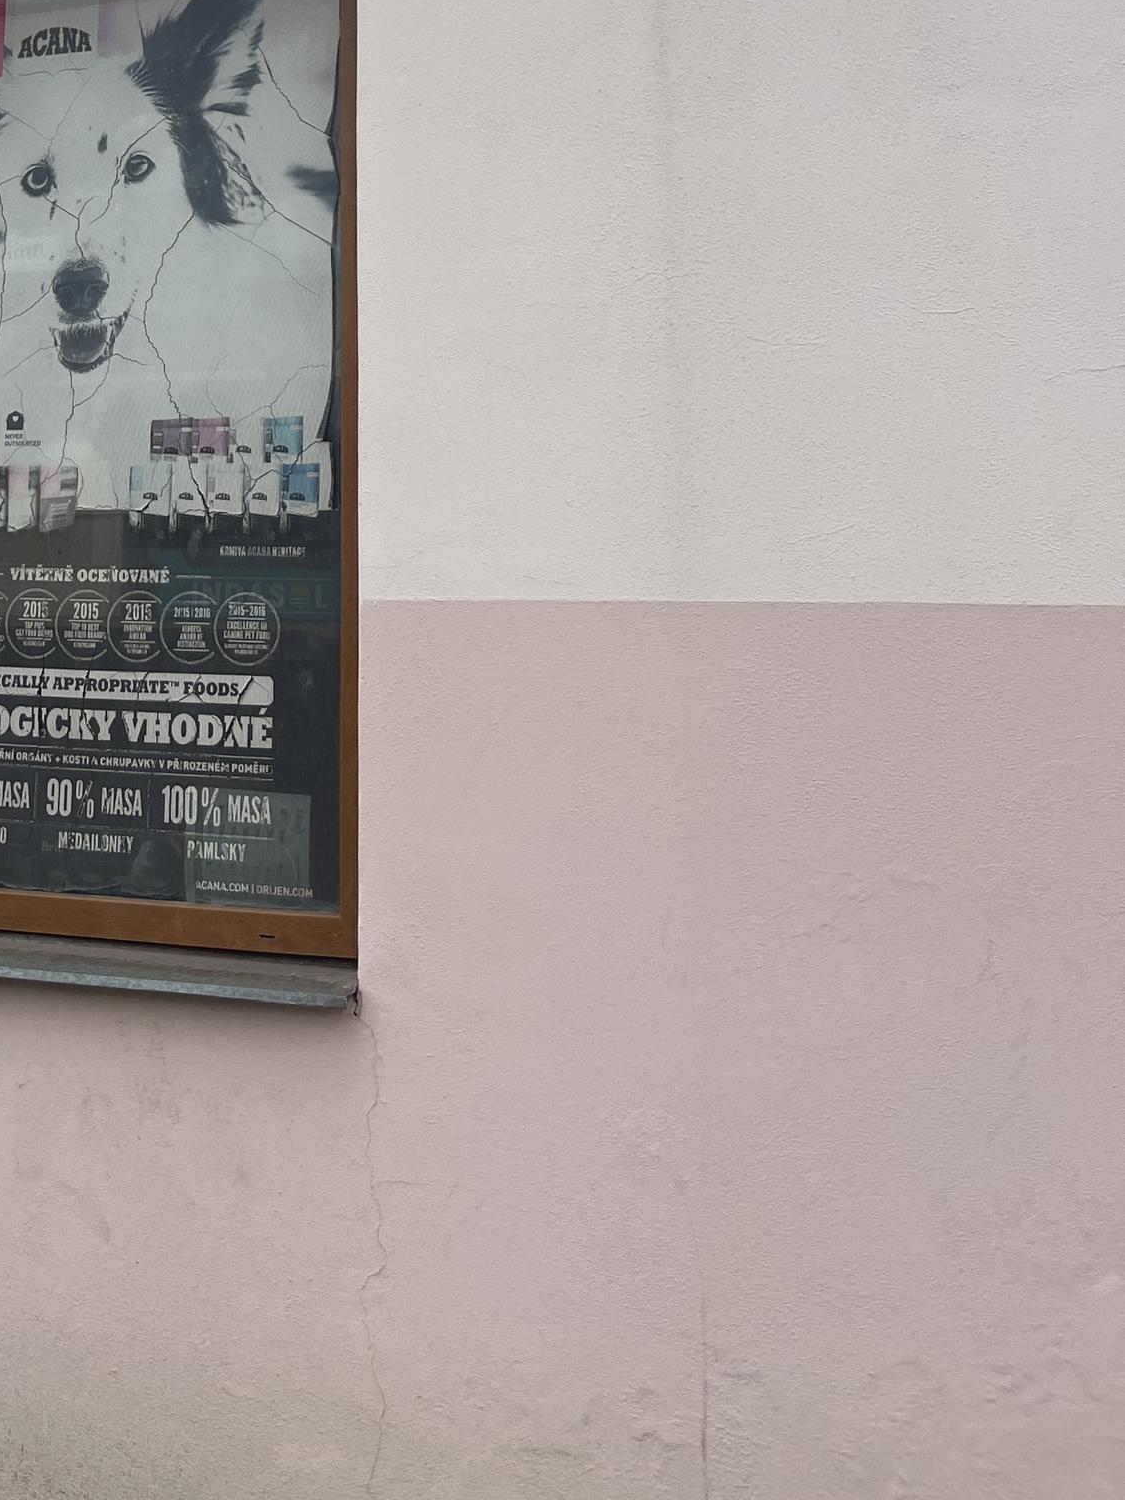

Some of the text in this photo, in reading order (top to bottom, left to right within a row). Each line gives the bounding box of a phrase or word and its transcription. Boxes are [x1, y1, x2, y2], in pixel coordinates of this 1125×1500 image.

[18, 26, 92, 59] ACANA
[219, 545, 246, 557] KRMIVA
[10, 564, 170, 583] VÍTĚZNĚ OCEŇOVANÉ
[22, 601, 49, 618] 2015
[73, 602, 99, 619] 2015
[125, 603, 152, 621] 2015
[227, 621, 260, 630] EXCELLENCE
[223, 631, 244, 639] CANINE
[244, 631, 255, 640] PET
[183, 681, 240, 697] FOODS
[121, 707, 273, 749] VHODNÉ
[16, 750, 53, 763] ORGÁNY
[62, 755, 89, 765] KOSTI
[100, 757, 156, 769] CHRUPAVKY
[158, 759, 165, 769] V
[167, 758, 229, 773] PŘIROZENÉM
[231, 761, 274, 775] POMĚRU
[101, 787, 143, 817] MASA
[227, 794, 272, 825] MASA
[58, 831, 134, 854] MEDAILONKY
[187, 840, 246, 862] PAMLSKY
[195, 880, 314, 898] ACANA.COM ORIJEN.COM
